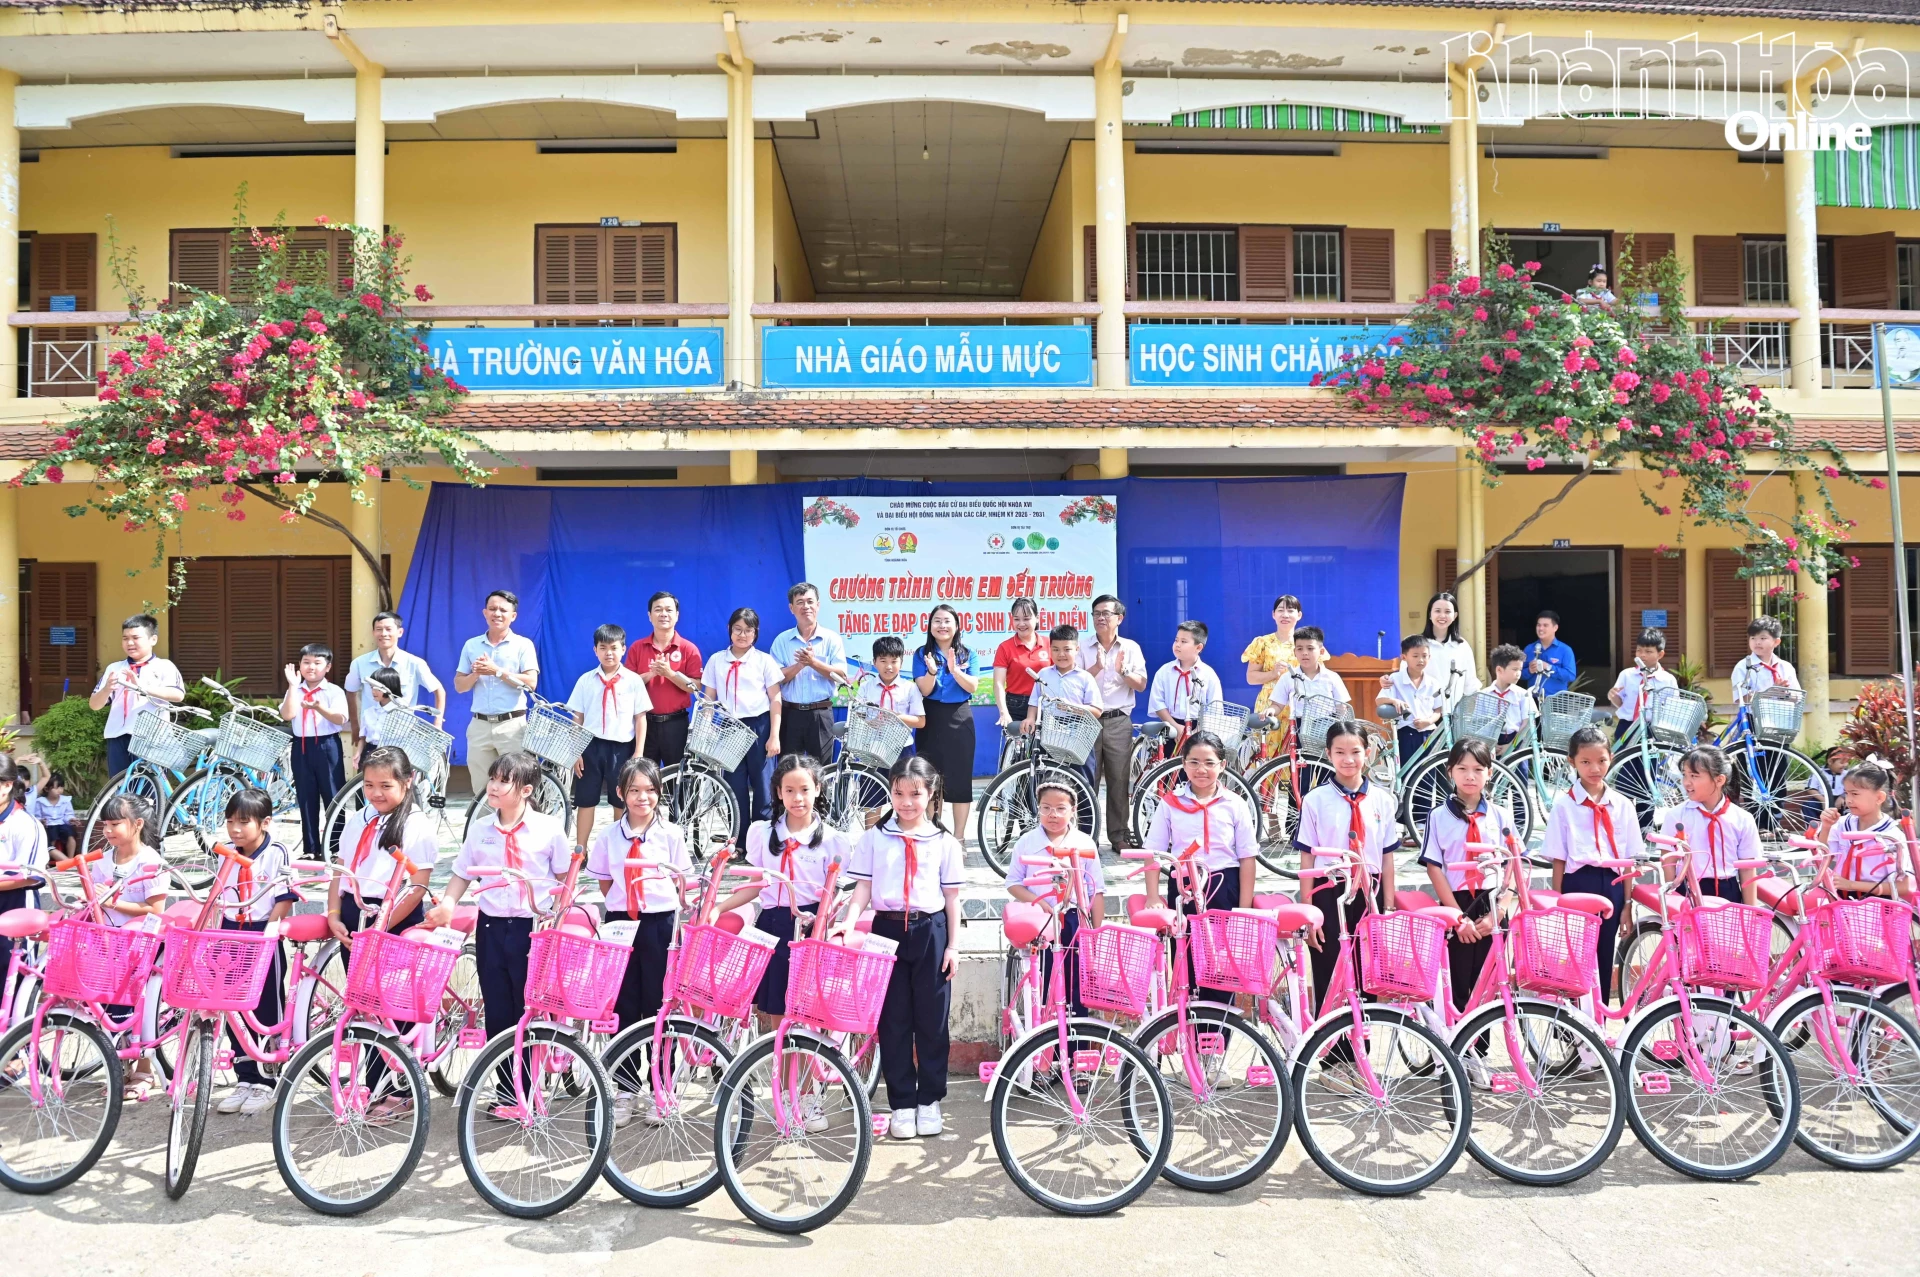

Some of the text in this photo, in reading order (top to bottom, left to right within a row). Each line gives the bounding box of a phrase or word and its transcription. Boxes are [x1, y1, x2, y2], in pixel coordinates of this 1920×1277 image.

[467, 338, 583, 376] TRƯỜNG
[590, 338, 645, 375] VĂN
[655, 338, 713, 375] HÓA
[795, 331, 1061, 378] NHÀ GIÁO MẪU MỰC
[1140, 342, 1195, 377] HỌC
[1203, 342, 1262, 373] SINH
[1270, 336, 1344, 373] CHĂM
[828, 567, 1094, 601] CHƯƠNG TRÌNH CÙNG EM ĐẾN TRƯỜNG
[838, 610, 870, 638] TẶNG
[873, 613, 890, 634] XE
[892, 613, 918, 637] ĐẠP
[975, 611, 1005, 633] SINH
